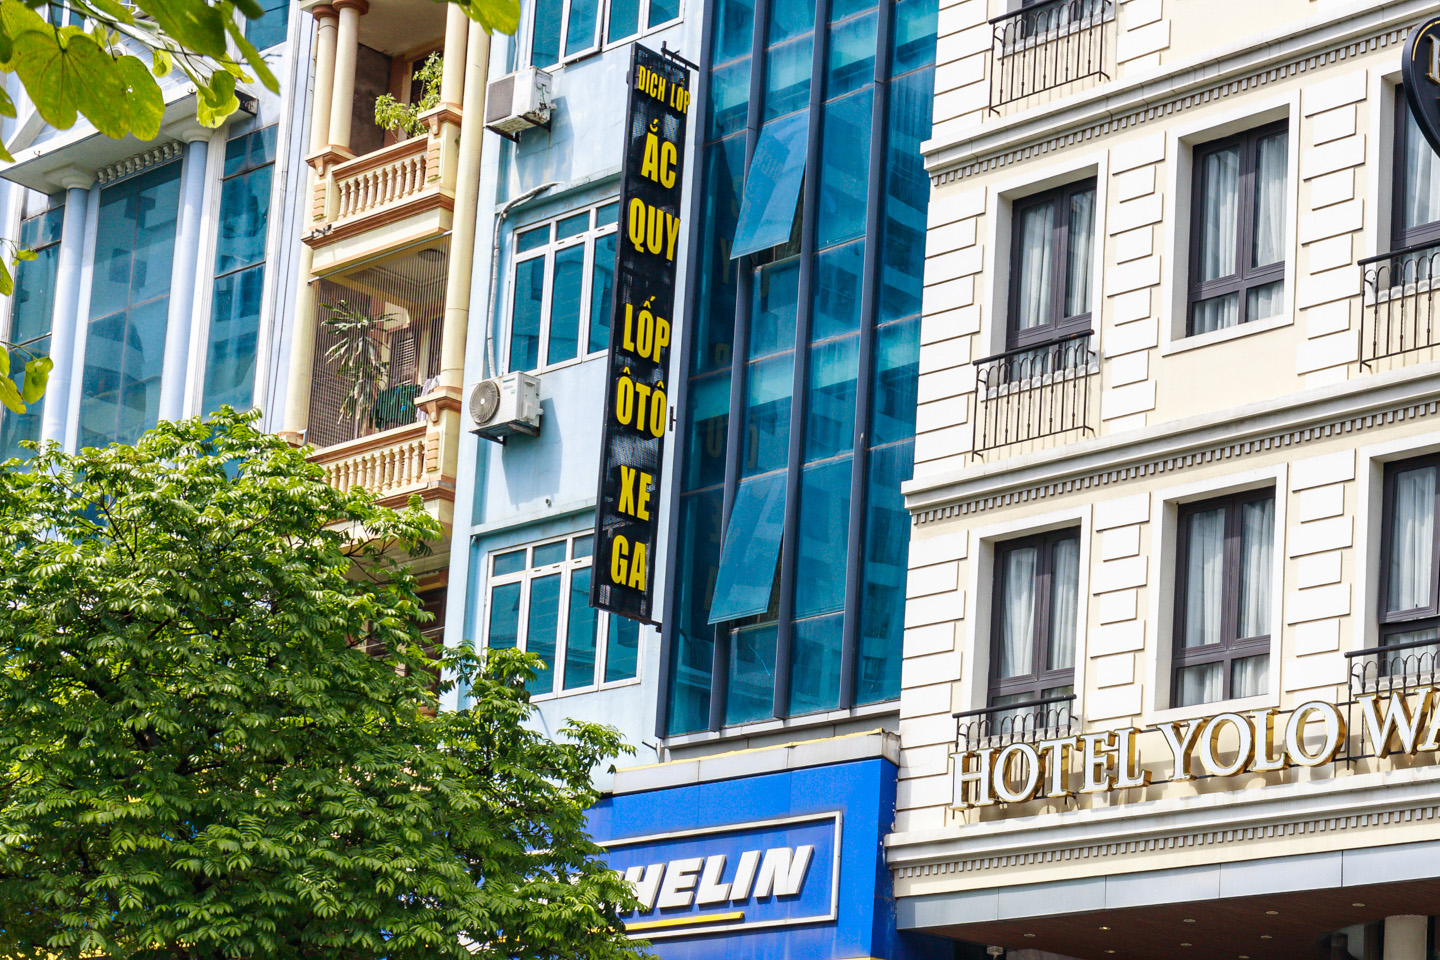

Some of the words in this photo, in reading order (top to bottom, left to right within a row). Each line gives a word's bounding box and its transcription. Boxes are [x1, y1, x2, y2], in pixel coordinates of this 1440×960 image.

[638, 65, 666, 102] ĐÍCH
[670, 78, 690, 114] LỐP
[640, 118, 677, 191] ẮC
[628, 197, 681, 264] QUY
[624, 296, 670, 365] LỐP
[616, 369, 667, 439] ÔTÔ
[617, 463, 653, 523] XE
[610, 533, 647, 592] GA
[950, 727, 1152, 811] HOTEL
[1157, 700, 1346, 781] YOLO
